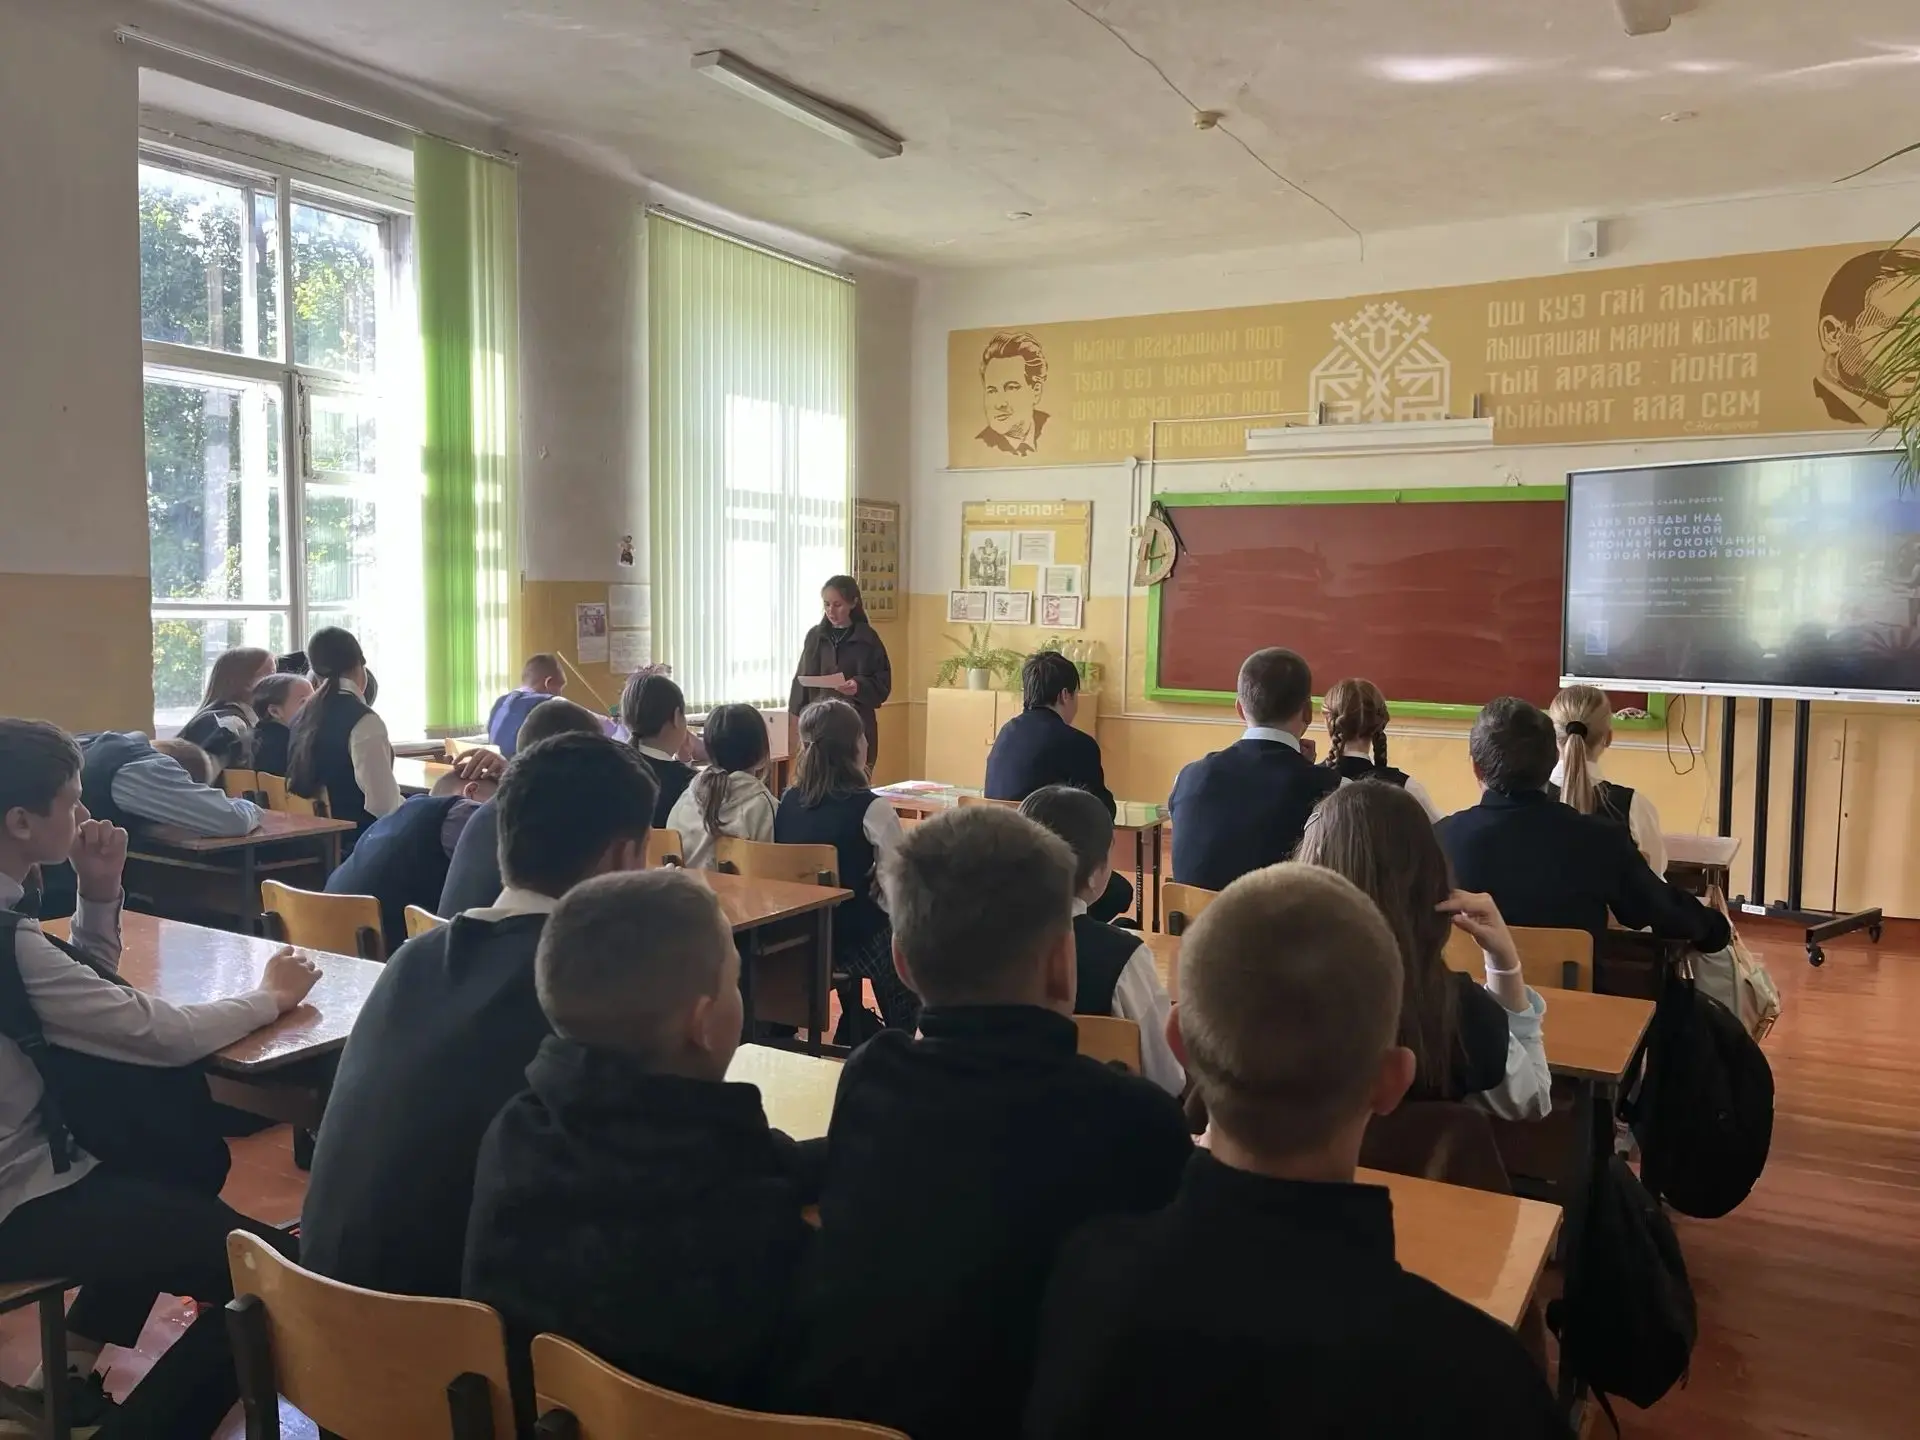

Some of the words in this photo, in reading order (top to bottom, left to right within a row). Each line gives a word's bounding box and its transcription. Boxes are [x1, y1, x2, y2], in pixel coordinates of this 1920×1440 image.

[1487, 300, 1525, 328] ОШ
[1600, 284, 1645, 316] ГАЙ
[1484, 365, 1539, 396] ТЫЙ
[1701, 390, 1762, 418] СЕМ
[1628, 513, 1688, 526] ПОБЕДЫ
